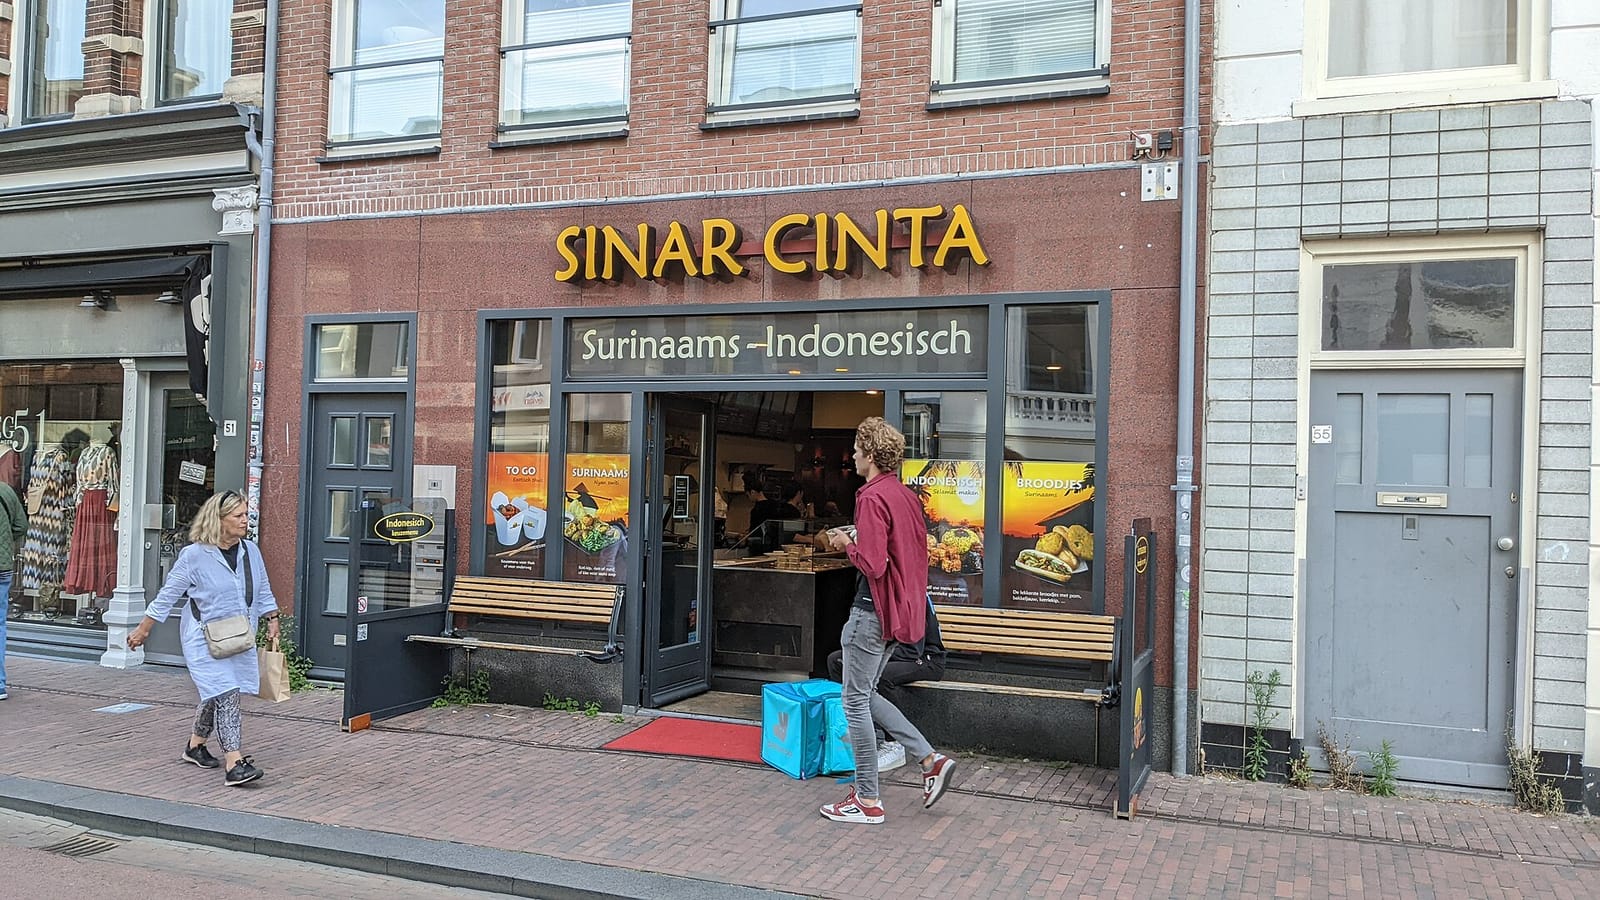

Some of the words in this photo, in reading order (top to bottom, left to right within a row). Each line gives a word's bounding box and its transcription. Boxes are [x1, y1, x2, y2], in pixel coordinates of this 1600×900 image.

[555, 218, 746, 283] SINAR
[763, 204, 990, 274] CINTA
[581, 328, 740, 361] Surinaams
[766, 320, 972, 358] Indonesisch
[0, 407, 45, 453] G51
[225, 423, 235, 433] 51
[1313, 428, 1331, 440] 55
[505, 466, 520, 475] TO
[521, 466, 536, 476] GO
[572, 467, 629, 479] SURINAAMS
[1016, 478, 1083, 490] BROODJES
[1025, 490, 1058, 498] Surinaams
[386, 517, 425, 528] Indonesisch
